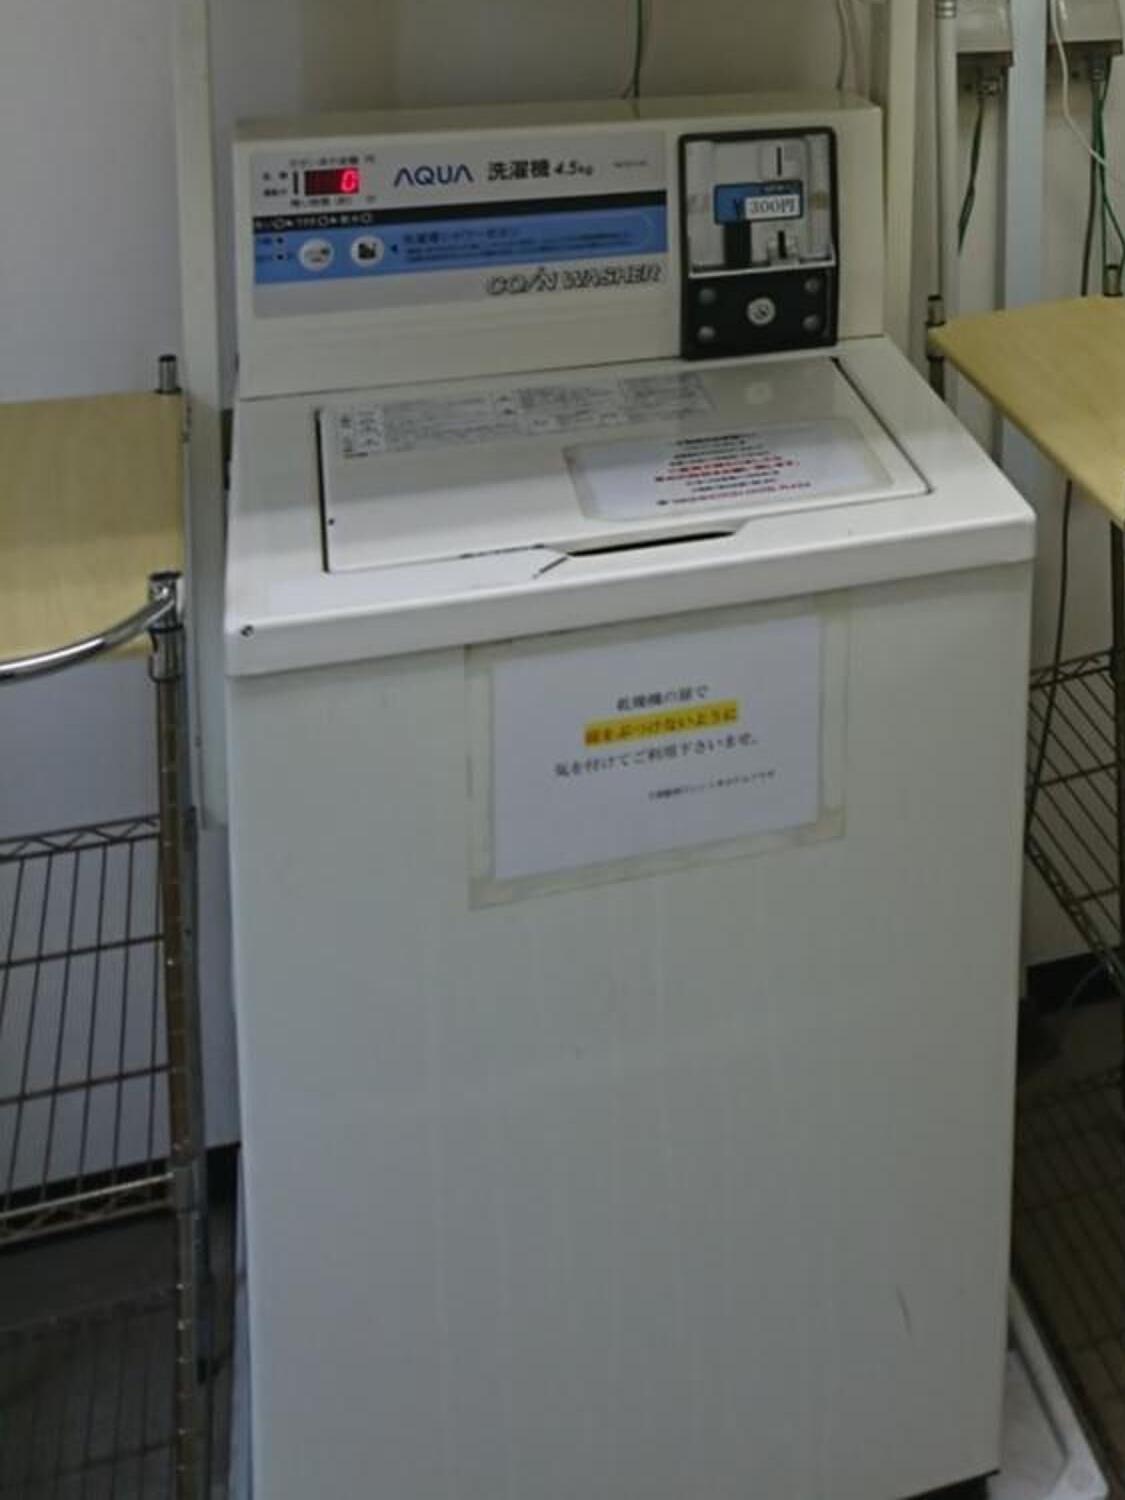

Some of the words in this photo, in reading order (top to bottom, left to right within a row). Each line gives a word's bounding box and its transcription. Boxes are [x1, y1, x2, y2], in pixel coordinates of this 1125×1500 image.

[339, 169, 359, 193] 0
[394, 164, 474, 188] AQUA
[487, 159, 551, 182] 洗濯機
[749, 196, 797, 216] 300円
